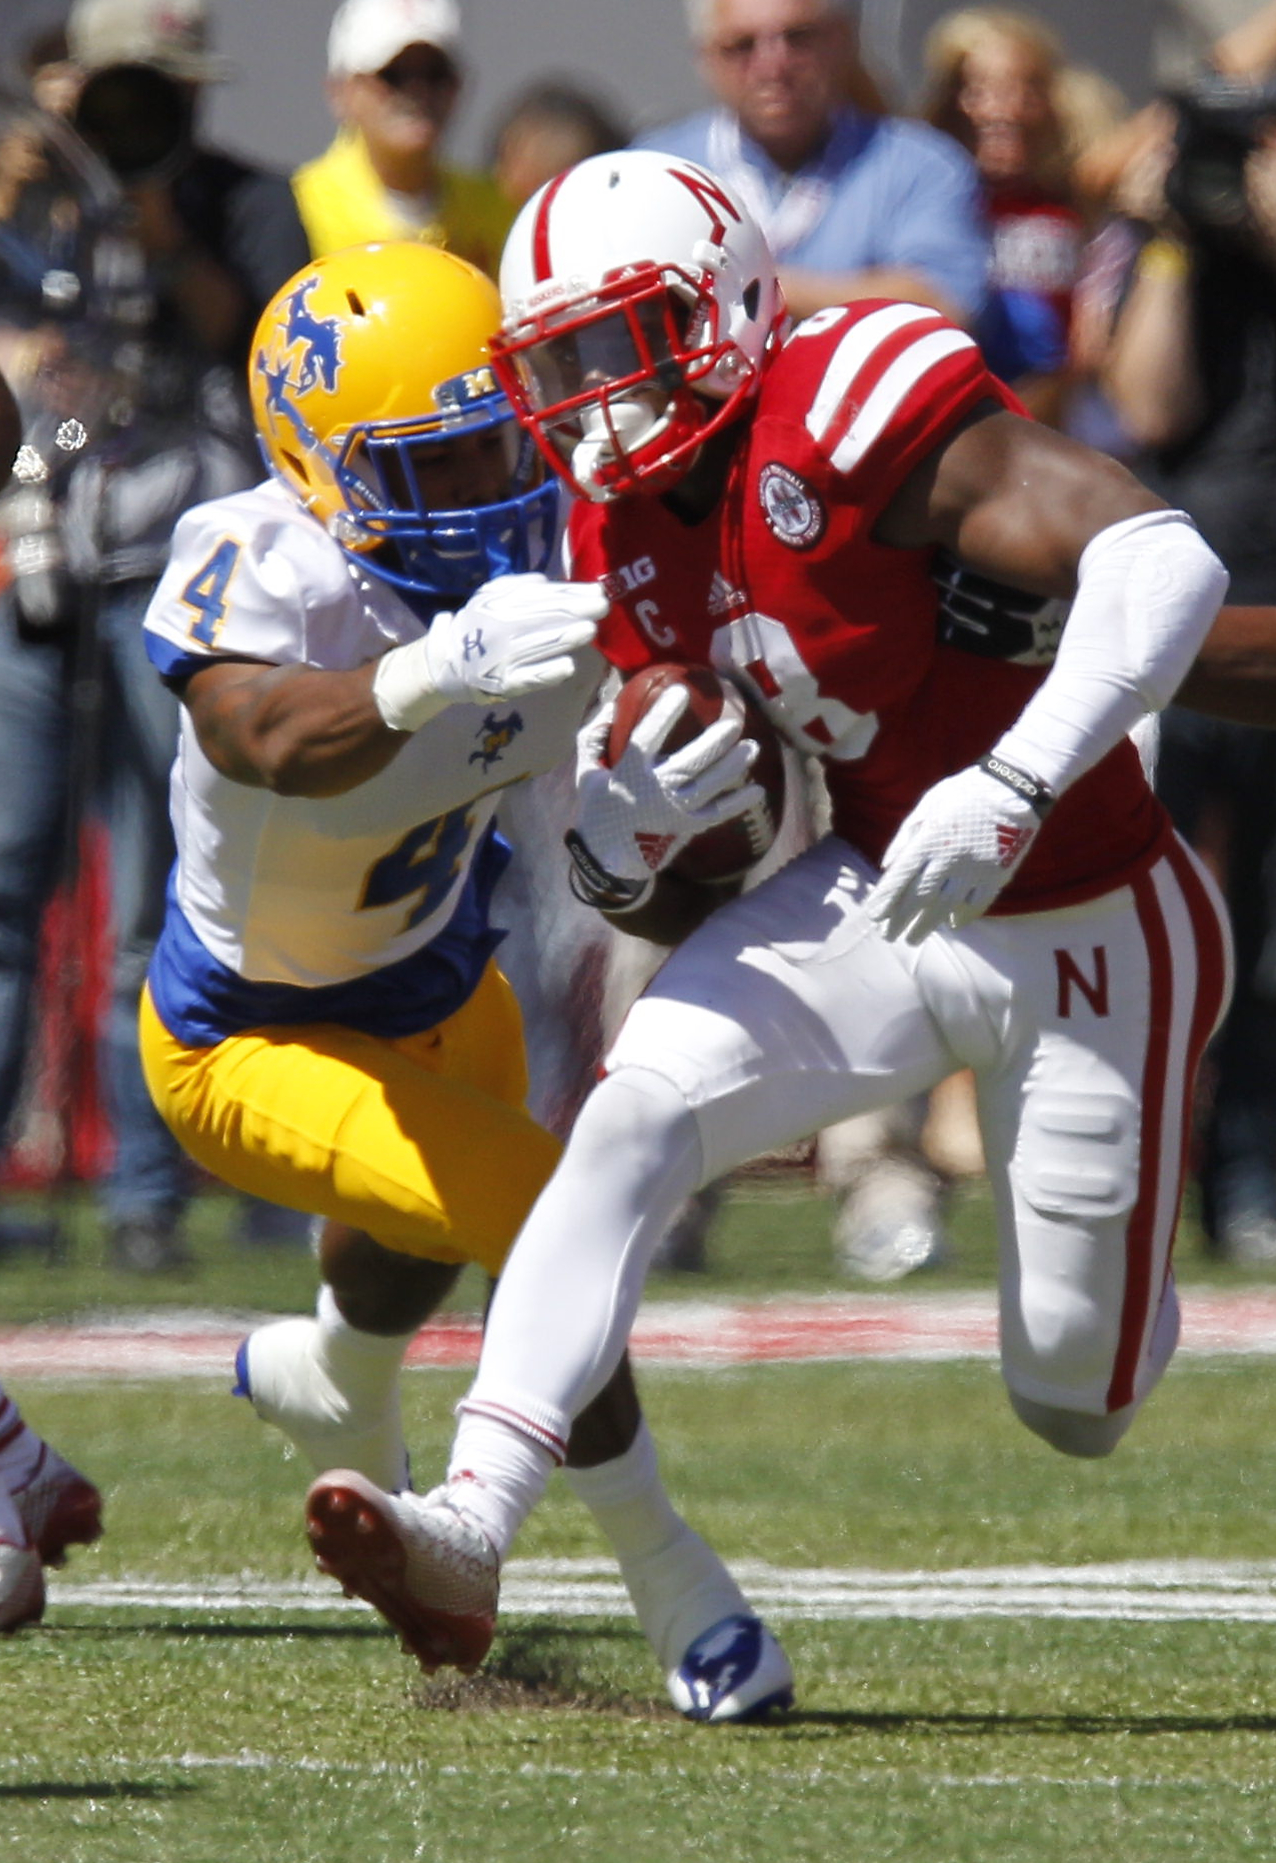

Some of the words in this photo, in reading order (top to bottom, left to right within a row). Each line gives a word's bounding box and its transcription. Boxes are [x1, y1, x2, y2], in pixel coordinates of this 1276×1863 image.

[462, 367, 497, 398] M
[178, 533, 245, 652] 4
[635, 599, 676, 647] C
[709, 612, 880, 762] 8
[987, 759, 1038, 796] adizero
[354, 785, 495, 937] 4
[1053, 944, 1110, 1019] N
